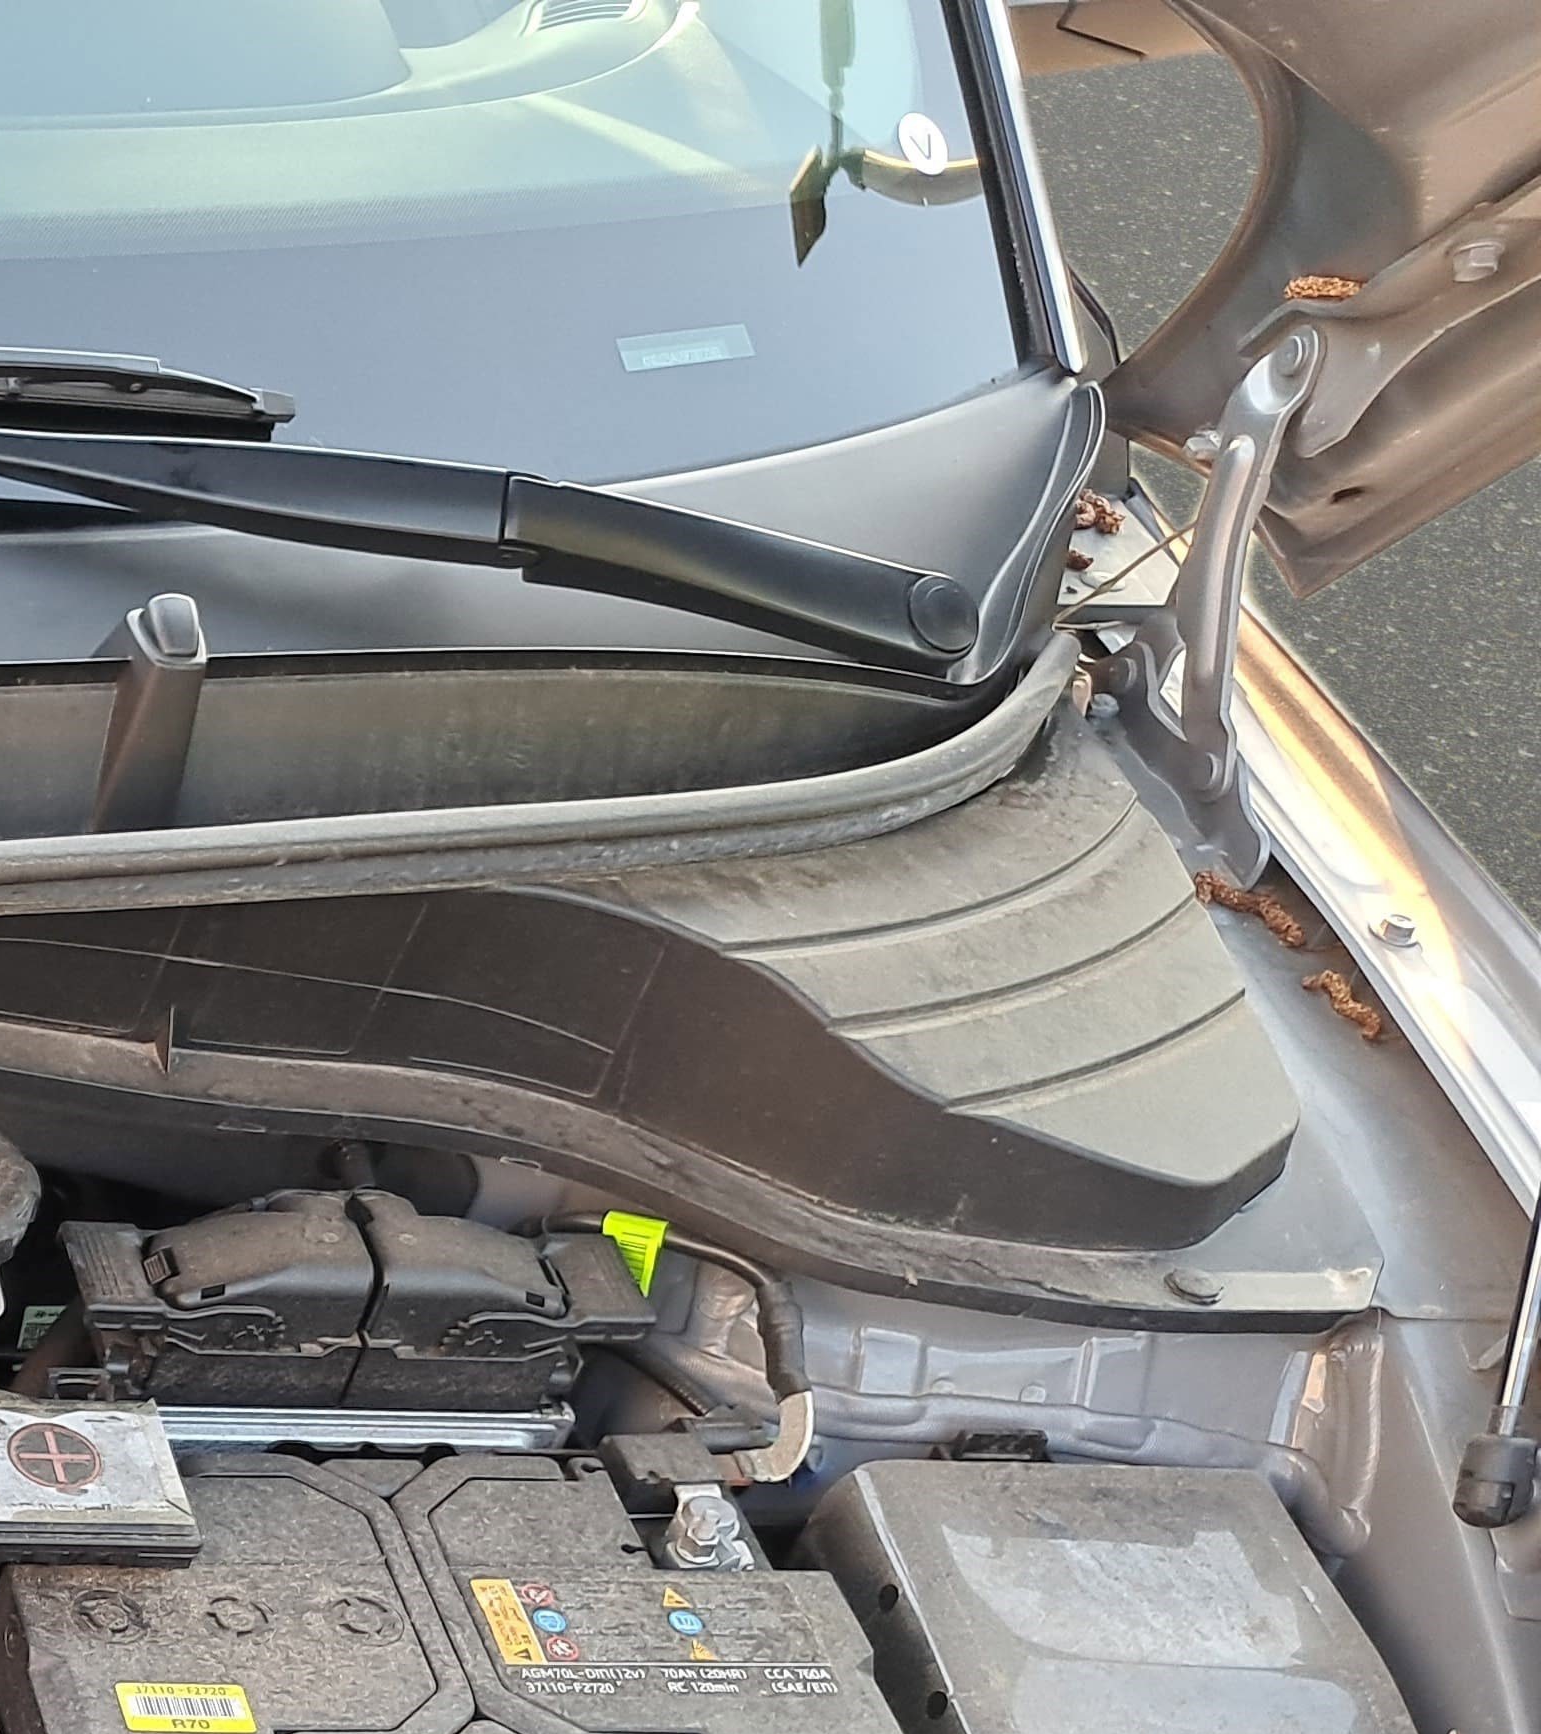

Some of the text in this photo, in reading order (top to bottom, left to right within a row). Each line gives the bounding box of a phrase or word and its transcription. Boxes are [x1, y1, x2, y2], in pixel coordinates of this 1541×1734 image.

[764, 1668, 794, 1680] CCA
[667, 1681, 689, 1693] RC
[172, 1718, 211, 1730] R70
